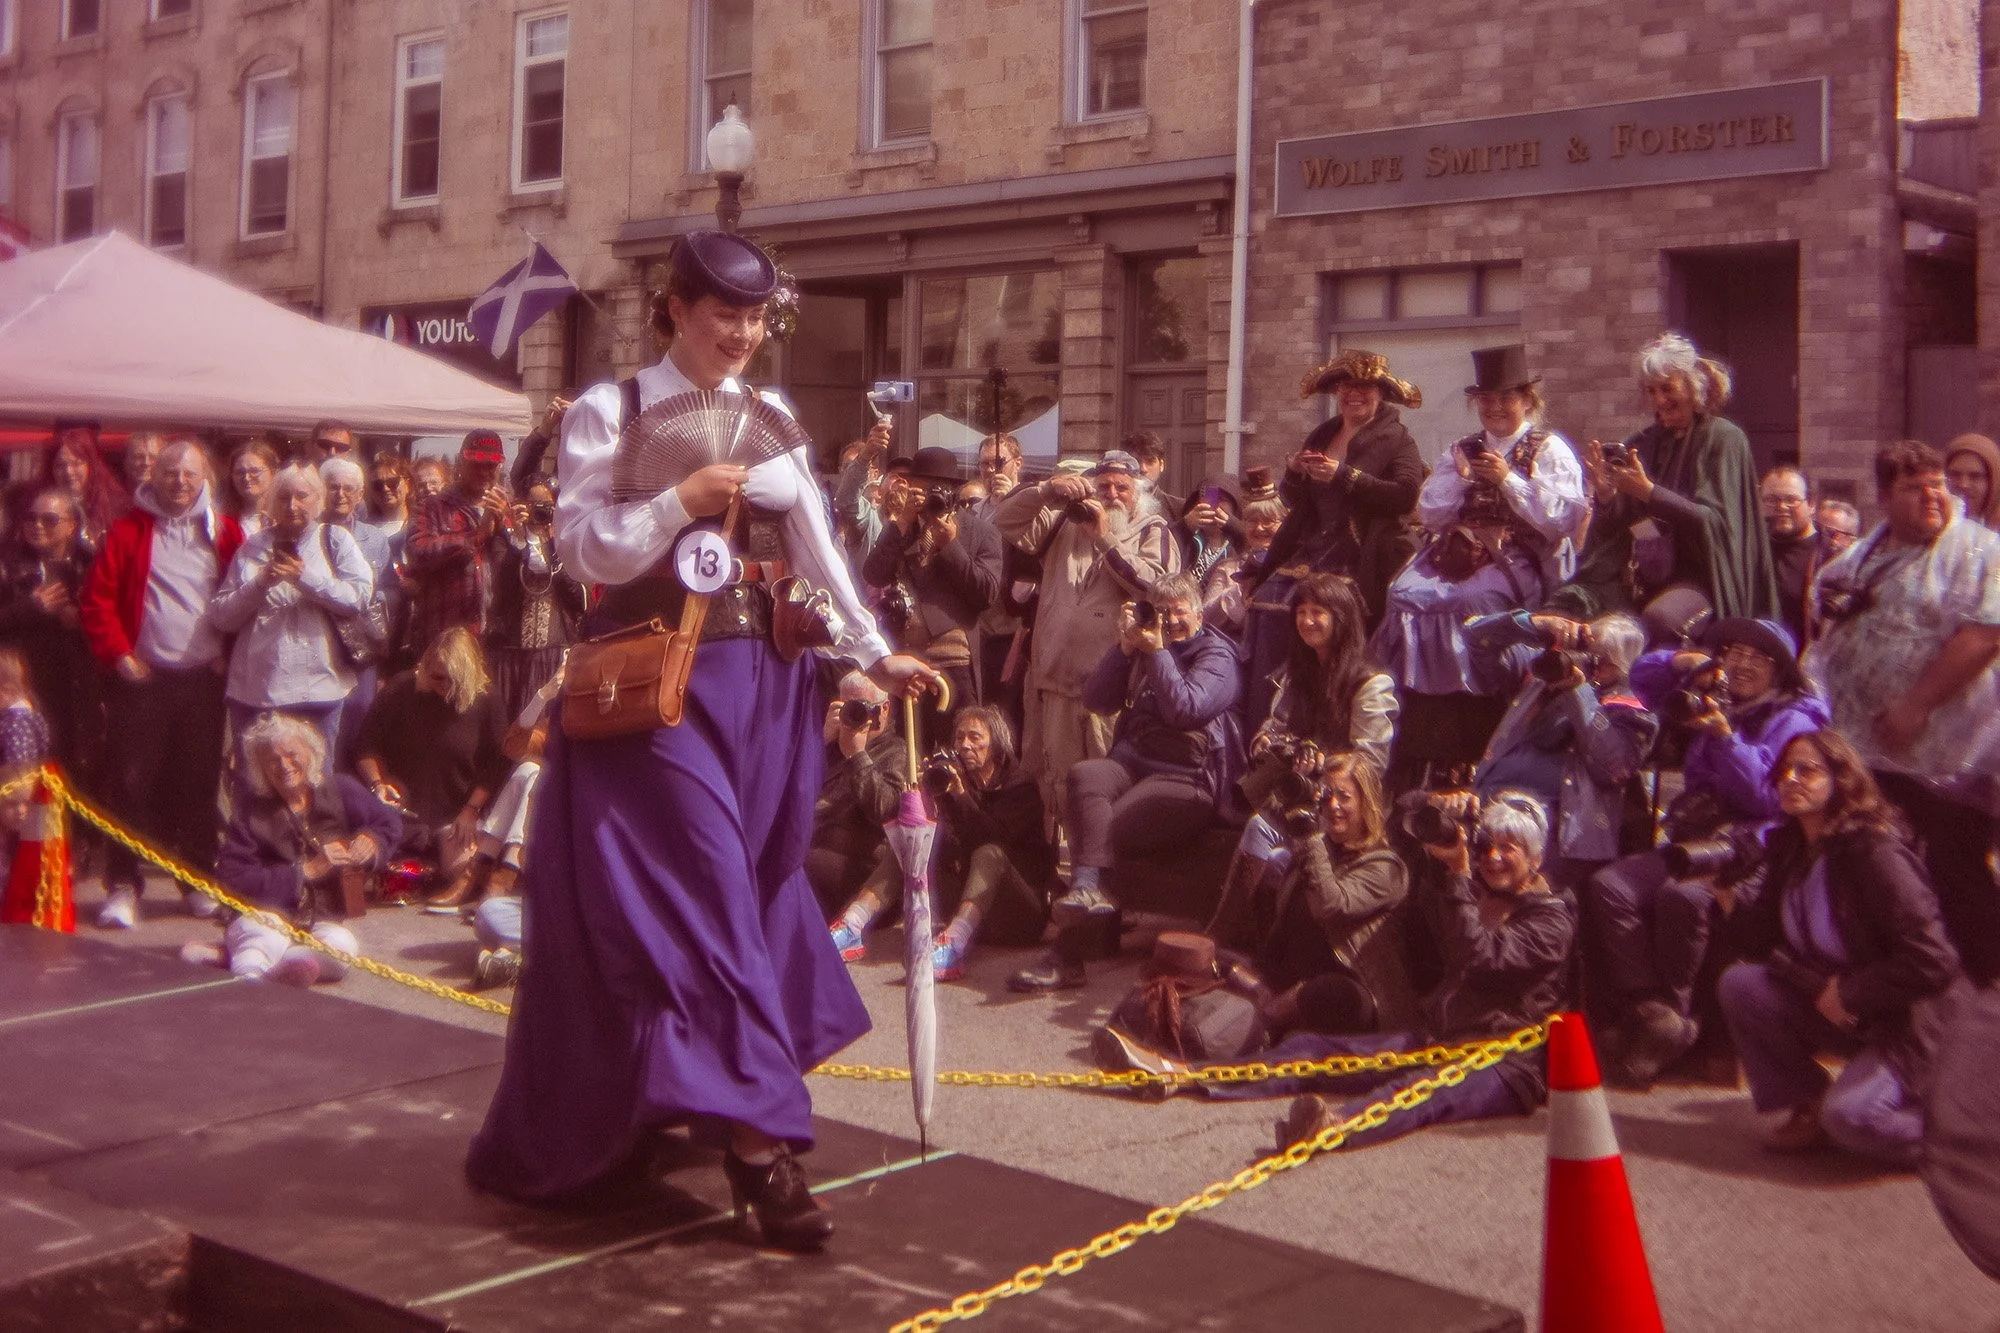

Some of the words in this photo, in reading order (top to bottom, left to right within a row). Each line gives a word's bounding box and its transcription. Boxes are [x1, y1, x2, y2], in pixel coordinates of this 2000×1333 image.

[1299, 156, 1403, 188] WOLFE
[1426, 142, 1540, 178] SMITH
[1568, 136, 1590, 163] &
[1611, 113, 1797, 159] FORSTER
[689, 546, 719, 578] 13
